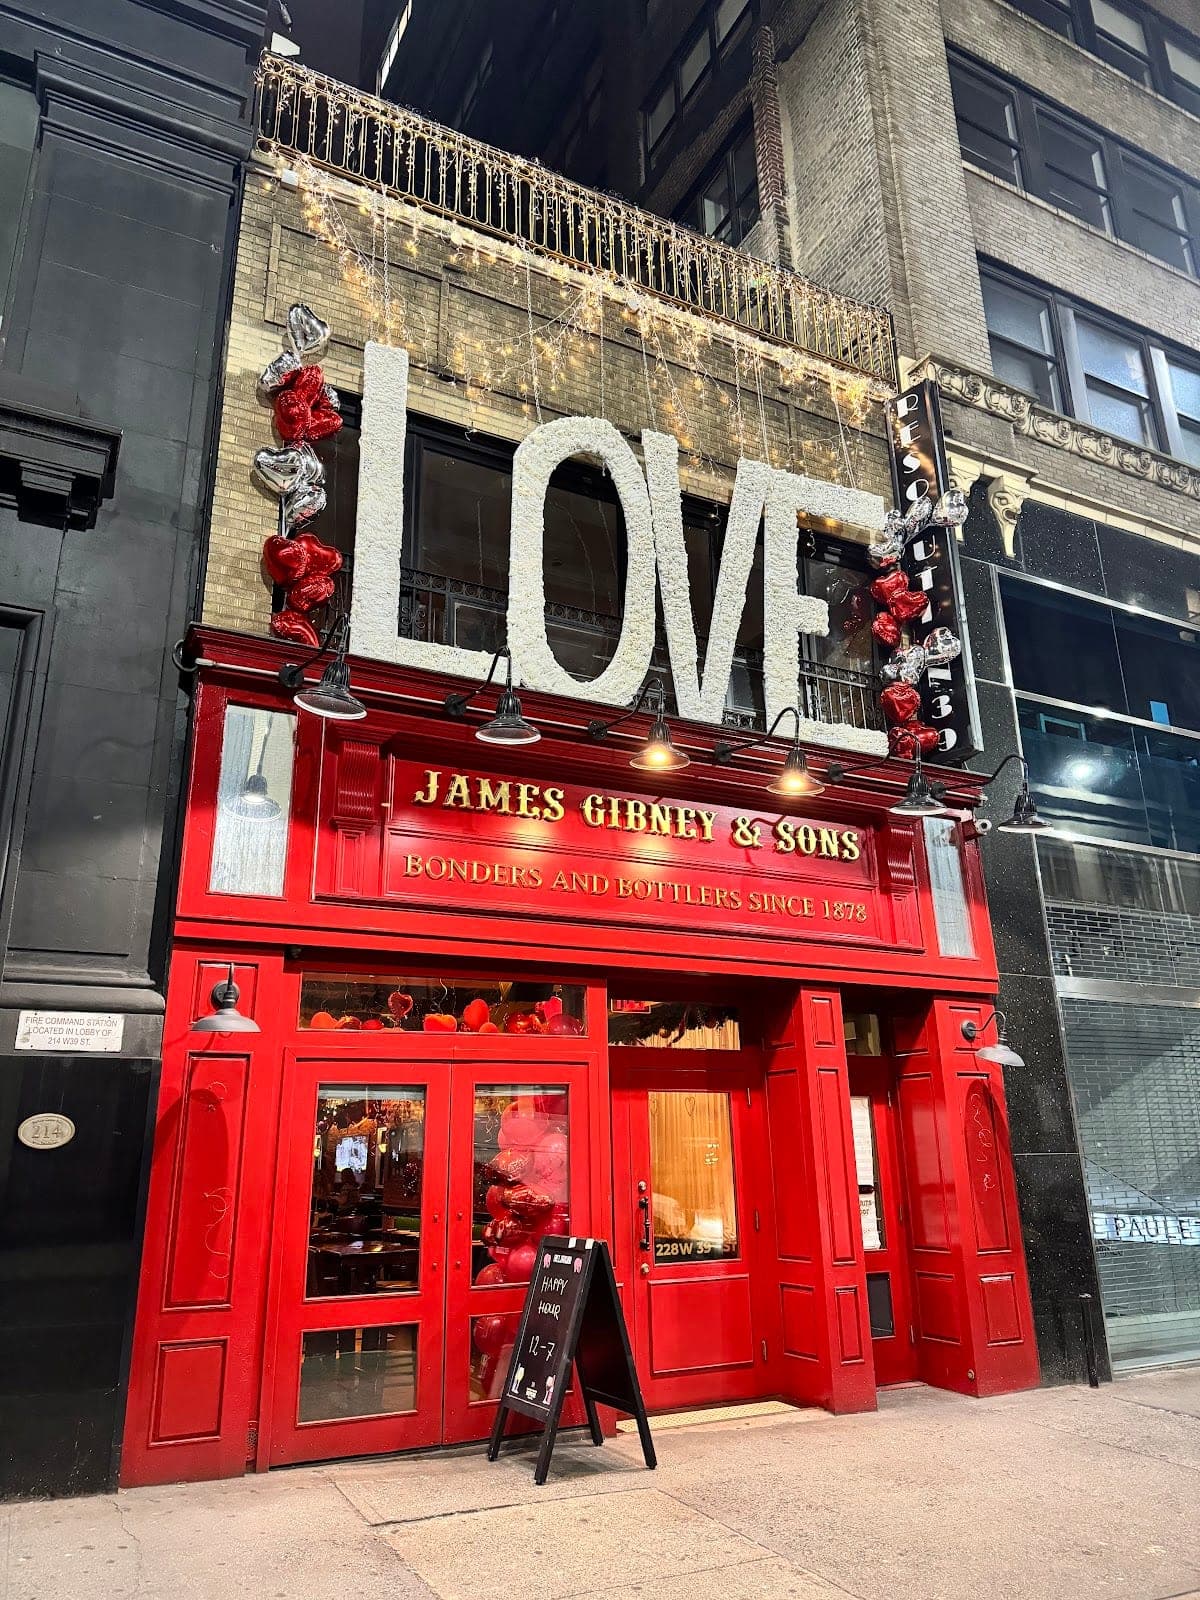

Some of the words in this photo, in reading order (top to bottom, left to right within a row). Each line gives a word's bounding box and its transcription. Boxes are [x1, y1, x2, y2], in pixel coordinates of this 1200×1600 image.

[348, 340, 889, 756] LOVE
[414, 769, 565, 822] JAMES
[581, 794, 718, 842] GIBNEY
[732, 815, 763, 849] &
[775, 821, 860, 861] SONS
[404, 854, 543, 888] BONDERS
[551, 870, 609, 896] AND
[616, 877, 742, 911] BOTTLERS
[749, 892, 816, 918] SINCE
[822, 899, 868, 923] 1878
[25, 1016, 44, 1026] FIRE
[45, 1017, 85, 1026] COMMAND
[86, 1018, 118, 1027] STATION
[28, 1026, 64, 1035] LOCATED
[65, 1027, 74, 1036] IN
[75, 1028, 100, 1037] LOBBY
[101, 1029, 113, 1038] OF
[47, 1037, 61, 1045] 214
[31, 1123, 62, 1139] 214
[540, 1275, 568, 1296] HAPPY
[538, 1301, 561, 1321] HOUR
[528, 1335, 555, 1362] 12-7
